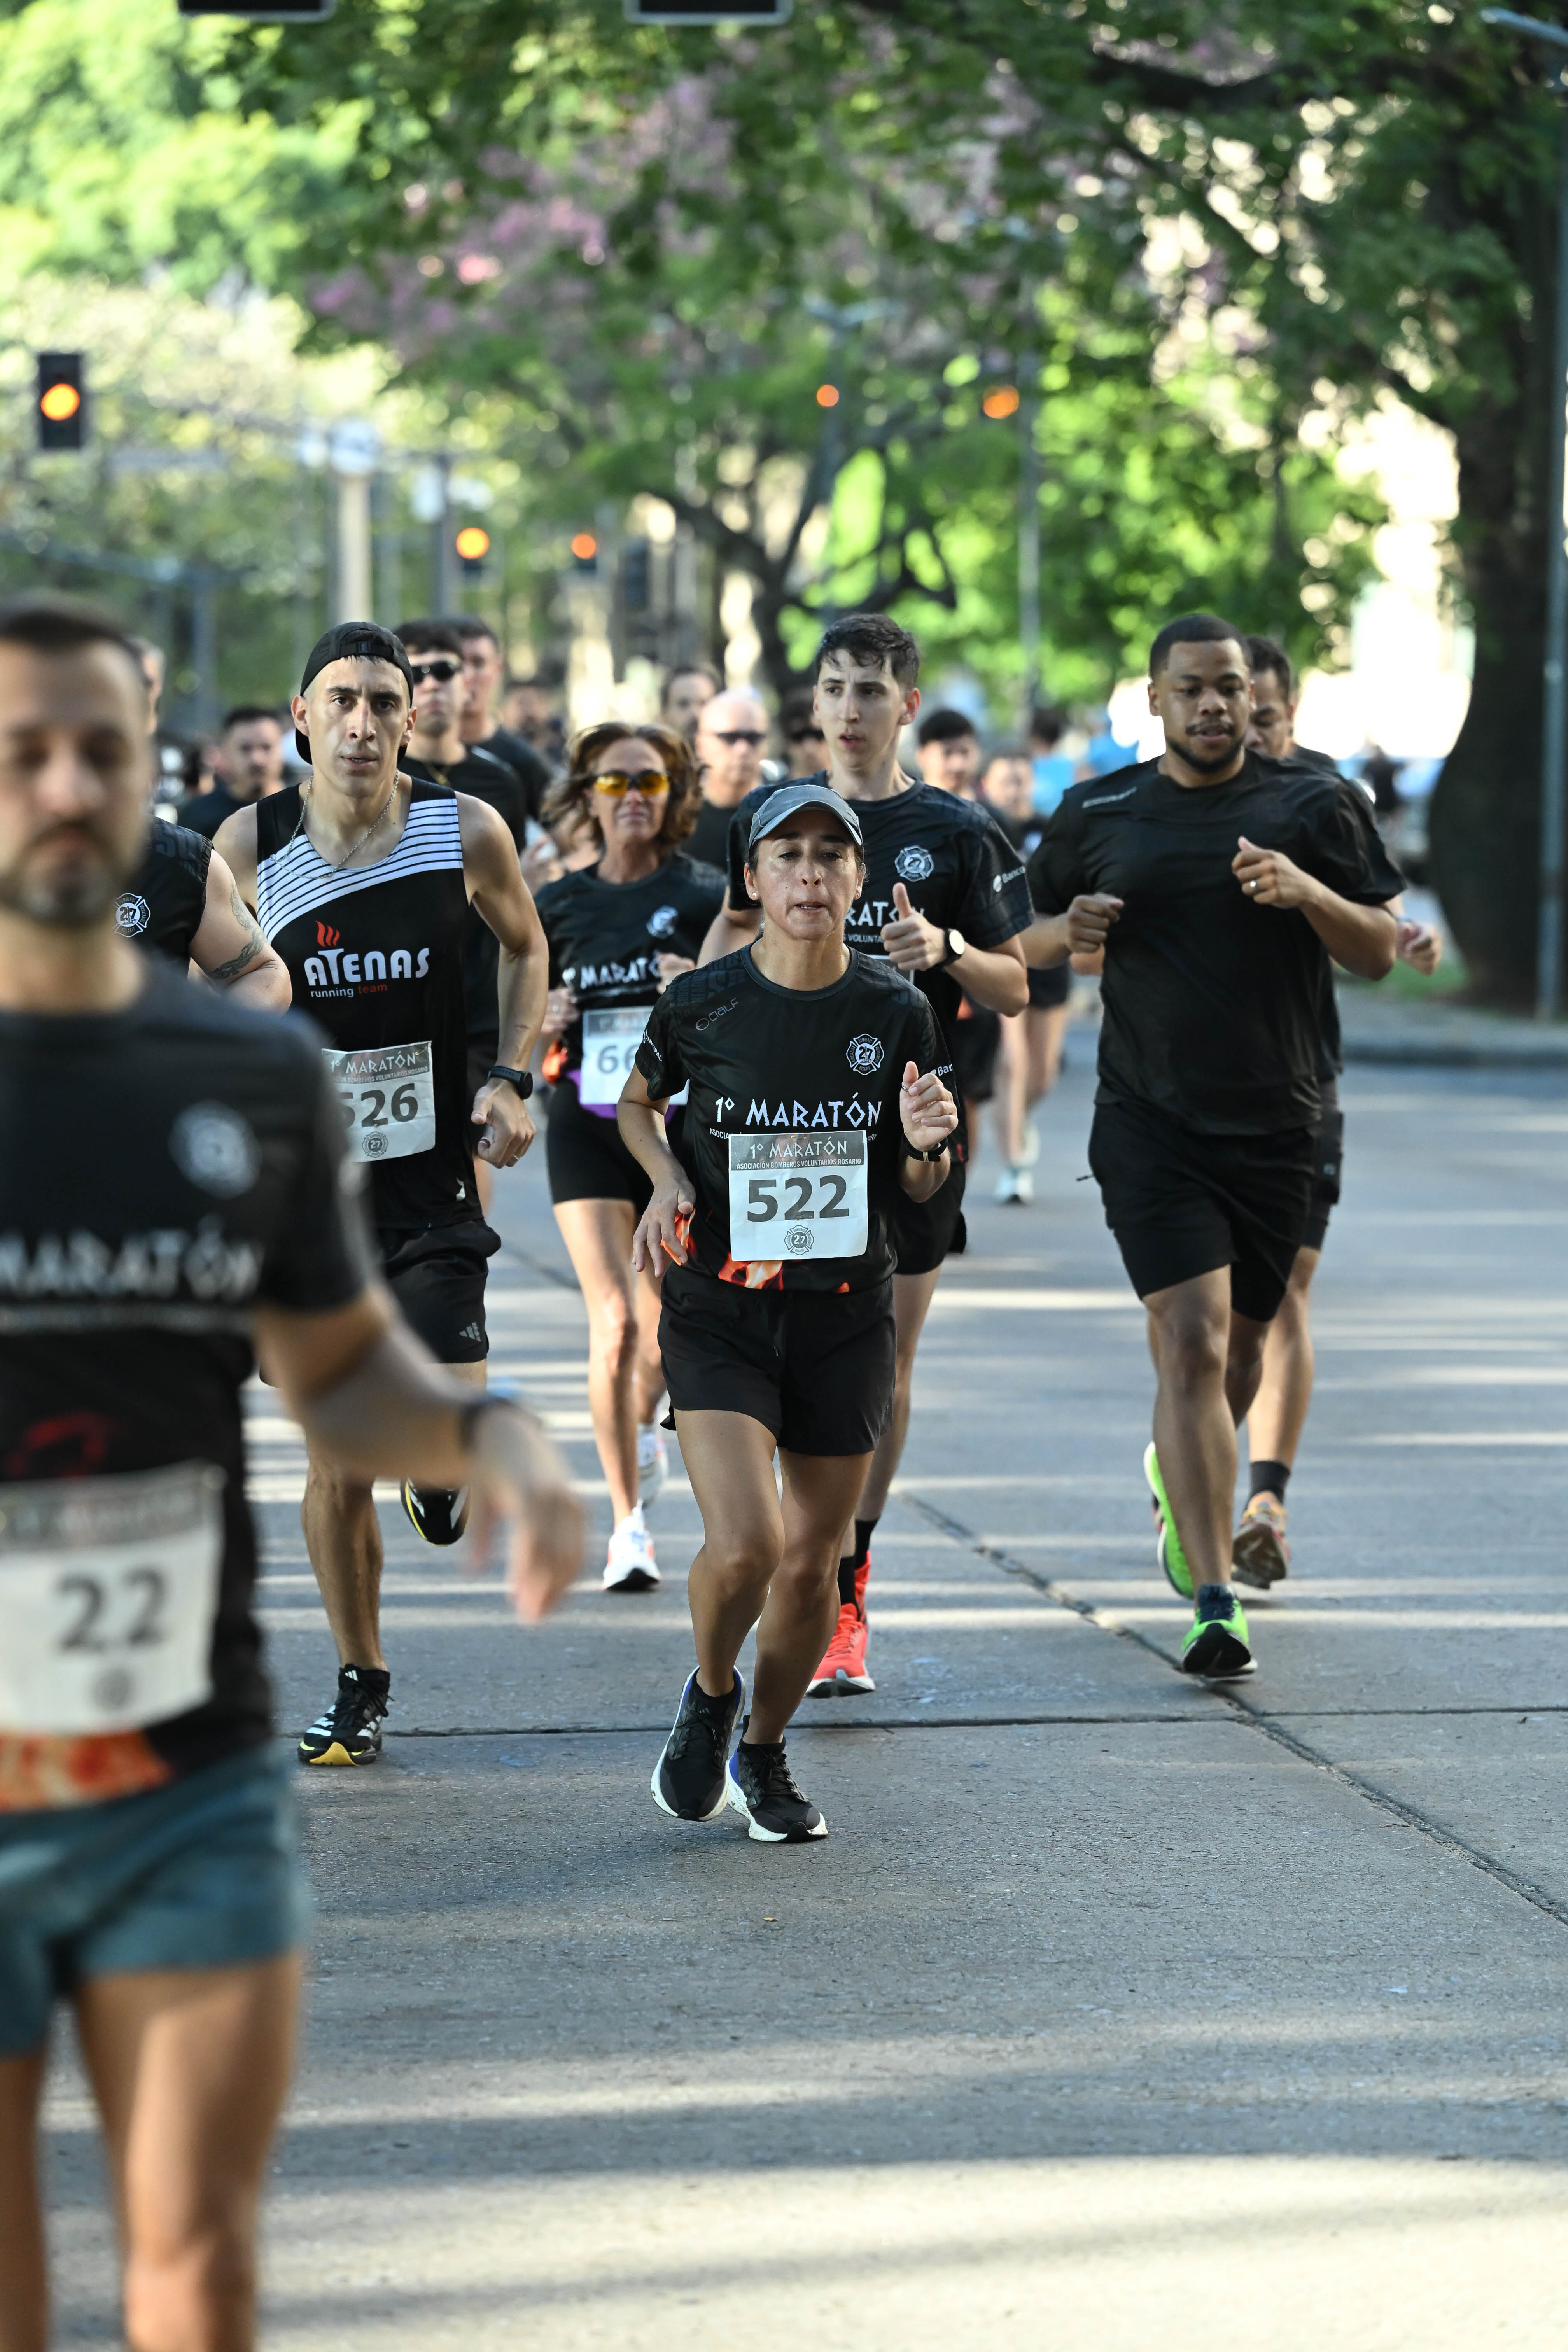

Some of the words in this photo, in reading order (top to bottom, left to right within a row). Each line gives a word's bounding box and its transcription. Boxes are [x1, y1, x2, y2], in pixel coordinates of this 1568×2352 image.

[120, 906, 137, 921] 27
[304, 948, 429, 986] ATENAS
[311, 987, 354, 998] running
[358, 984, 388, 994] team
[859, 1046, 873, 1060] 27
[346, 1051, 416, 1074] MARATÓN
[375, 1070, 408, 1081] VOLUNTARIOS
[408, 1066, 428, 1075] ROSARIO
[746, 1092, 882, 1128] MARATÓN
[710, 1127, 730, 1139] ASOCIA
[370, 1140, 381, 1149] 27
[769, 1136, 847, 1158] MARATÓN
[737, 1161, 770, 1170] ASOCIACIÓN
[746, 1174, 850, 1222] 522
[794, 1234, 805, 1244] 27
[52, 1563, 165, 1657] 22
